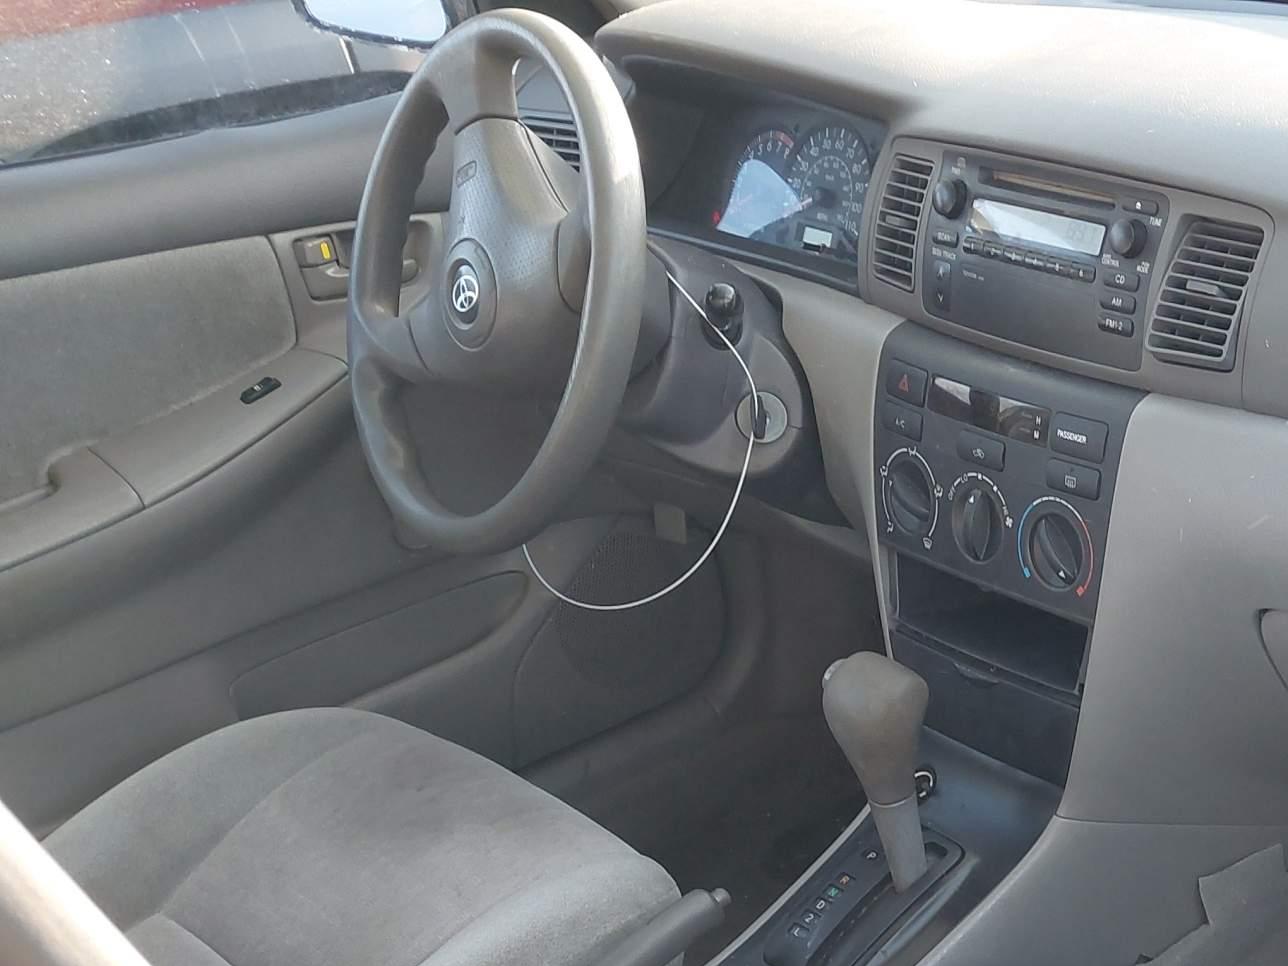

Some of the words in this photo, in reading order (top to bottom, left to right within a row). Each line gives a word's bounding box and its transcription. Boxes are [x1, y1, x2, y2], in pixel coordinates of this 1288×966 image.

[1114, 273, 1126, 285] CD
[1111, 296, 1123, 307] AM
[1057, 428, 1087, 445] PASSENGER
[840, 876, 850, 885] R
[829, 887, 838, 896] N
[816, 900, 825, 909] D
[805, 914, 814, 923] 2
